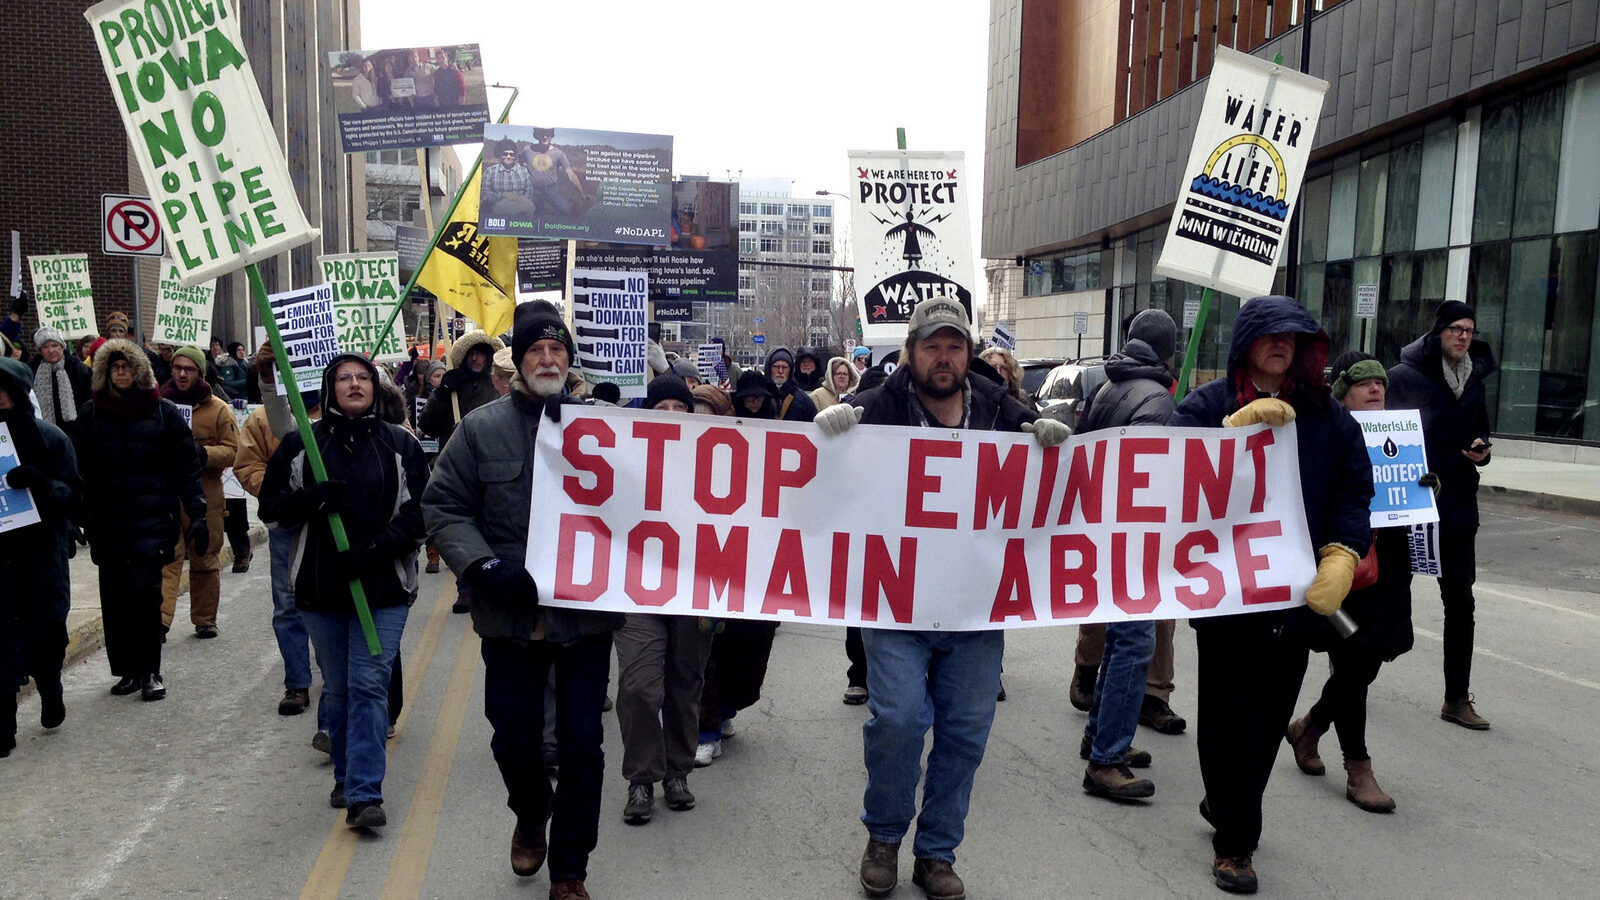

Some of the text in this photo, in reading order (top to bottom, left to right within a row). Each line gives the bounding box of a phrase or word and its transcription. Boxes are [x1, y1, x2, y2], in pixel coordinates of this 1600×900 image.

[117, 27, 246, 113] IOWA
[139, 90, 226, 169] NO
[1224, 95, 1302, 148] WATER
[1248, 146, 1257, 159] IS
[162, 152, 233, 193] OIL
[871, 169, 944, 180] WE ARE HERE TO
[1221, 153, 1272, 192] LIFE
[162, 166, 272, 234] PIPE
[860, 181, 957, 204] PROTECT
[488, 218, 505, 227] BOLD
[544, 222, 590, 232] BoldIowa.org
[614, 227, 665, 238] #NoDAPL
[1179, 214, 1212, 237] MNÍ
[176, 201, 286, 270] LINE
[32, 258, 88, 274] PROTECT
[616, 256, 641, 264] enough,
[671, 256, 689, 264] Rosie
[46, 273, 69, 281] OUR
[324, 259, 397, 281] PROTECT
[630, 267, 662, 275] protecting
[686, 267, 701, 275] land,
[702, 267, 716, 275] soil,
[36, 281, 82, 292] FUTURE
[332, 280, 397, 302] IOWA
[628, 278, 645, 293] NO
[680, 278, 710, 286] pipeline."
[164, 291, 207, 305] DOMAIN
[316, 288, 330, 300] NO
[591, 292, 645, 310] EMINENT
[878, 282, 960, 304] WATER
[45, 306, 68, 318] SOIL
[174, 305, 193, 316] FOR
[288, 300, 331, 319] EMINENT
[336, 307, 385, 327] SOIL
[596, 310, 645, 326] DOMAIN
[898, 304, 910, 314] IS
[158, 314, 208, 332] PRIVATE
[292, 312, 332, 330] DOMAIN
[164, 328, 196, 342] GAIN
[314, 325, 334, 339] FOR
[338, 325, 394, 343] WATER
[622, 327, 645, 342] FOR
[294, 338, 337, 356] PRIVATE
[596, 342, 645, 358] PRIVATE
[615, 359, 644, 374] GAIN
[1362, 420, 1418, 432] WaterIsLife
[561, 416, 1276, 531] STOP EMINENT
[1373, 464, 1423, 483] ROTECT
[1387, 487, 1408, 506] IT!
[1408, 536, 1419, 573] DOMAIN
[1415, 533, 1428, 574] EMINENT
[553, 510, 1292, 625] DOMAIN ABUSE
[1428, 562, 1438, 575] NO
